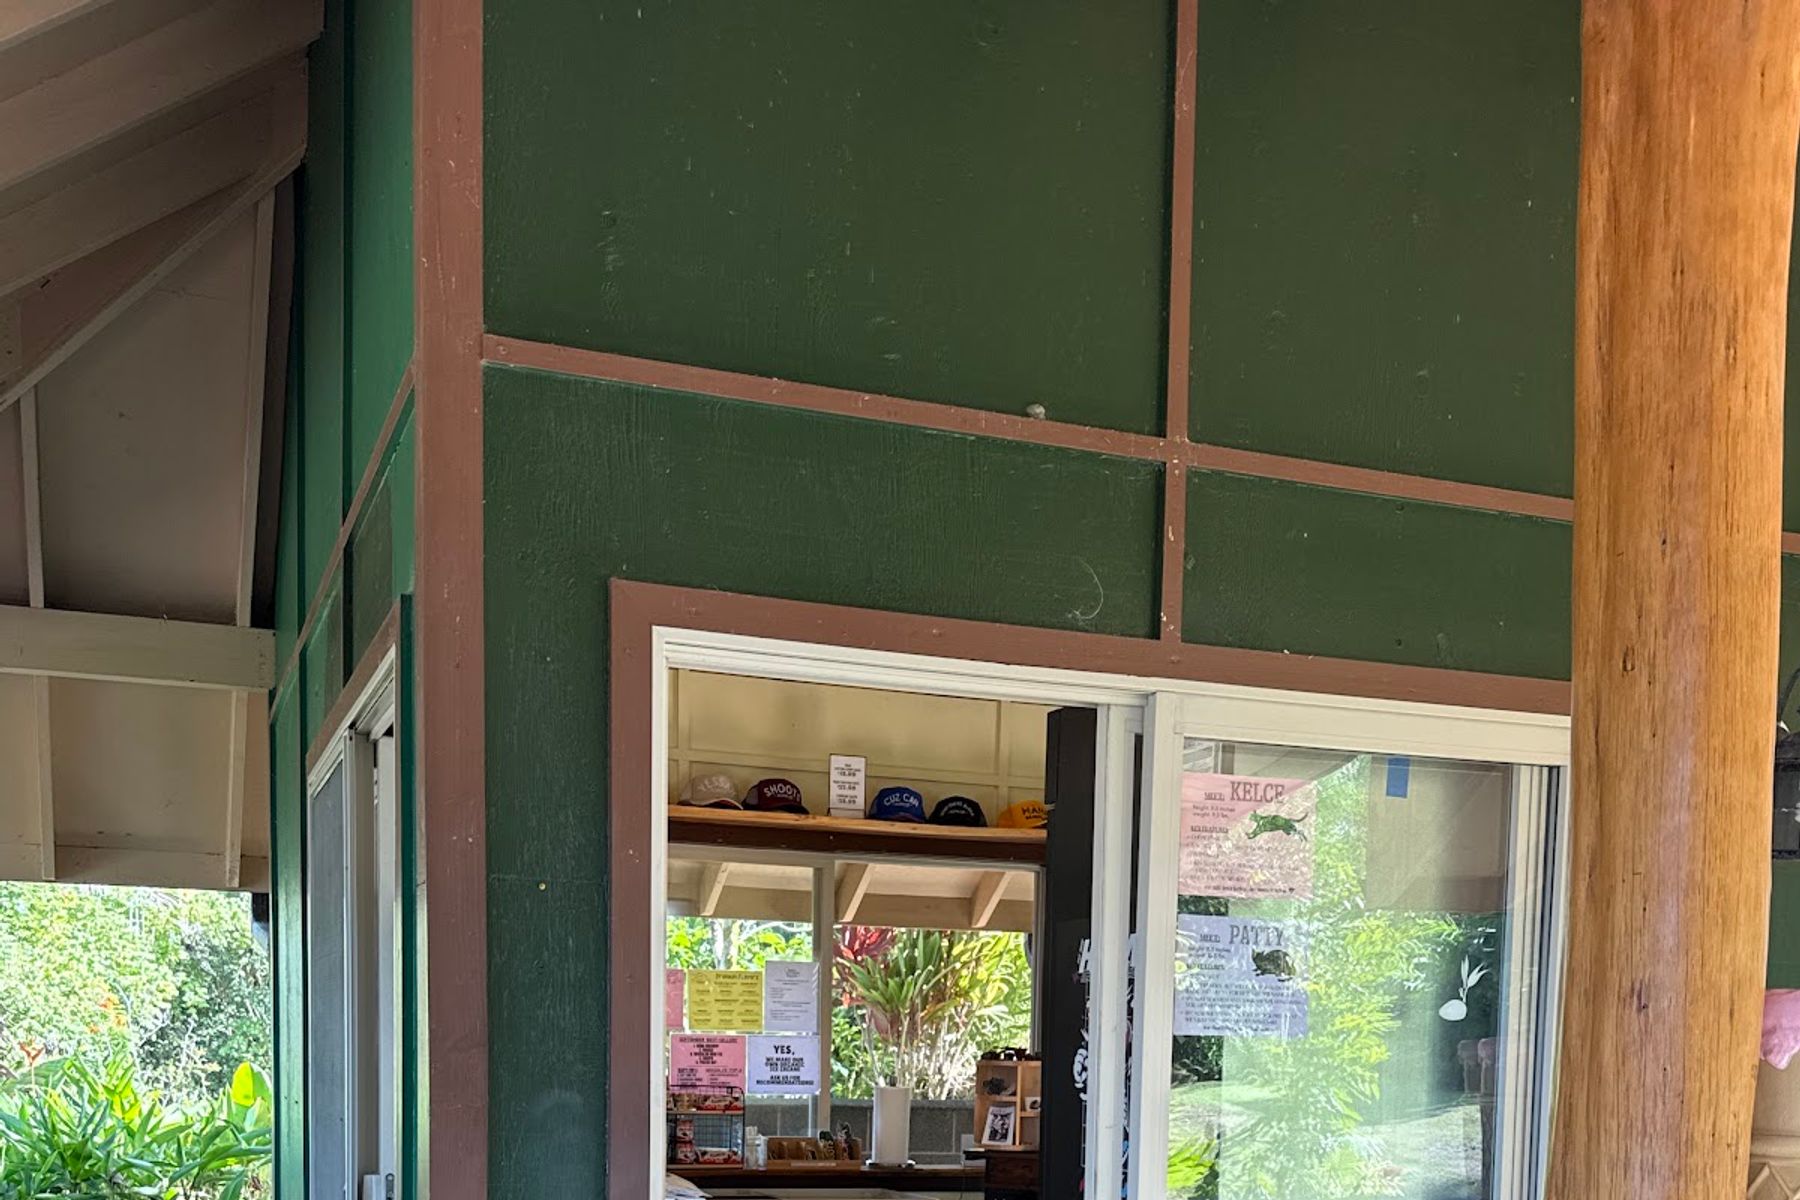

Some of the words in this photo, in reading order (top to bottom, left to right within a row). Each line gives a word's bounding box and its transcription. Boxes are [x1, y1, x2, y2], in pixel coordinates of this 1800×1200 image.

[1230, 781, 1285, 804] KELCE
[1229, 924, 1284, 947] PATTY
[773, 1045, 795, 1056] YES,
